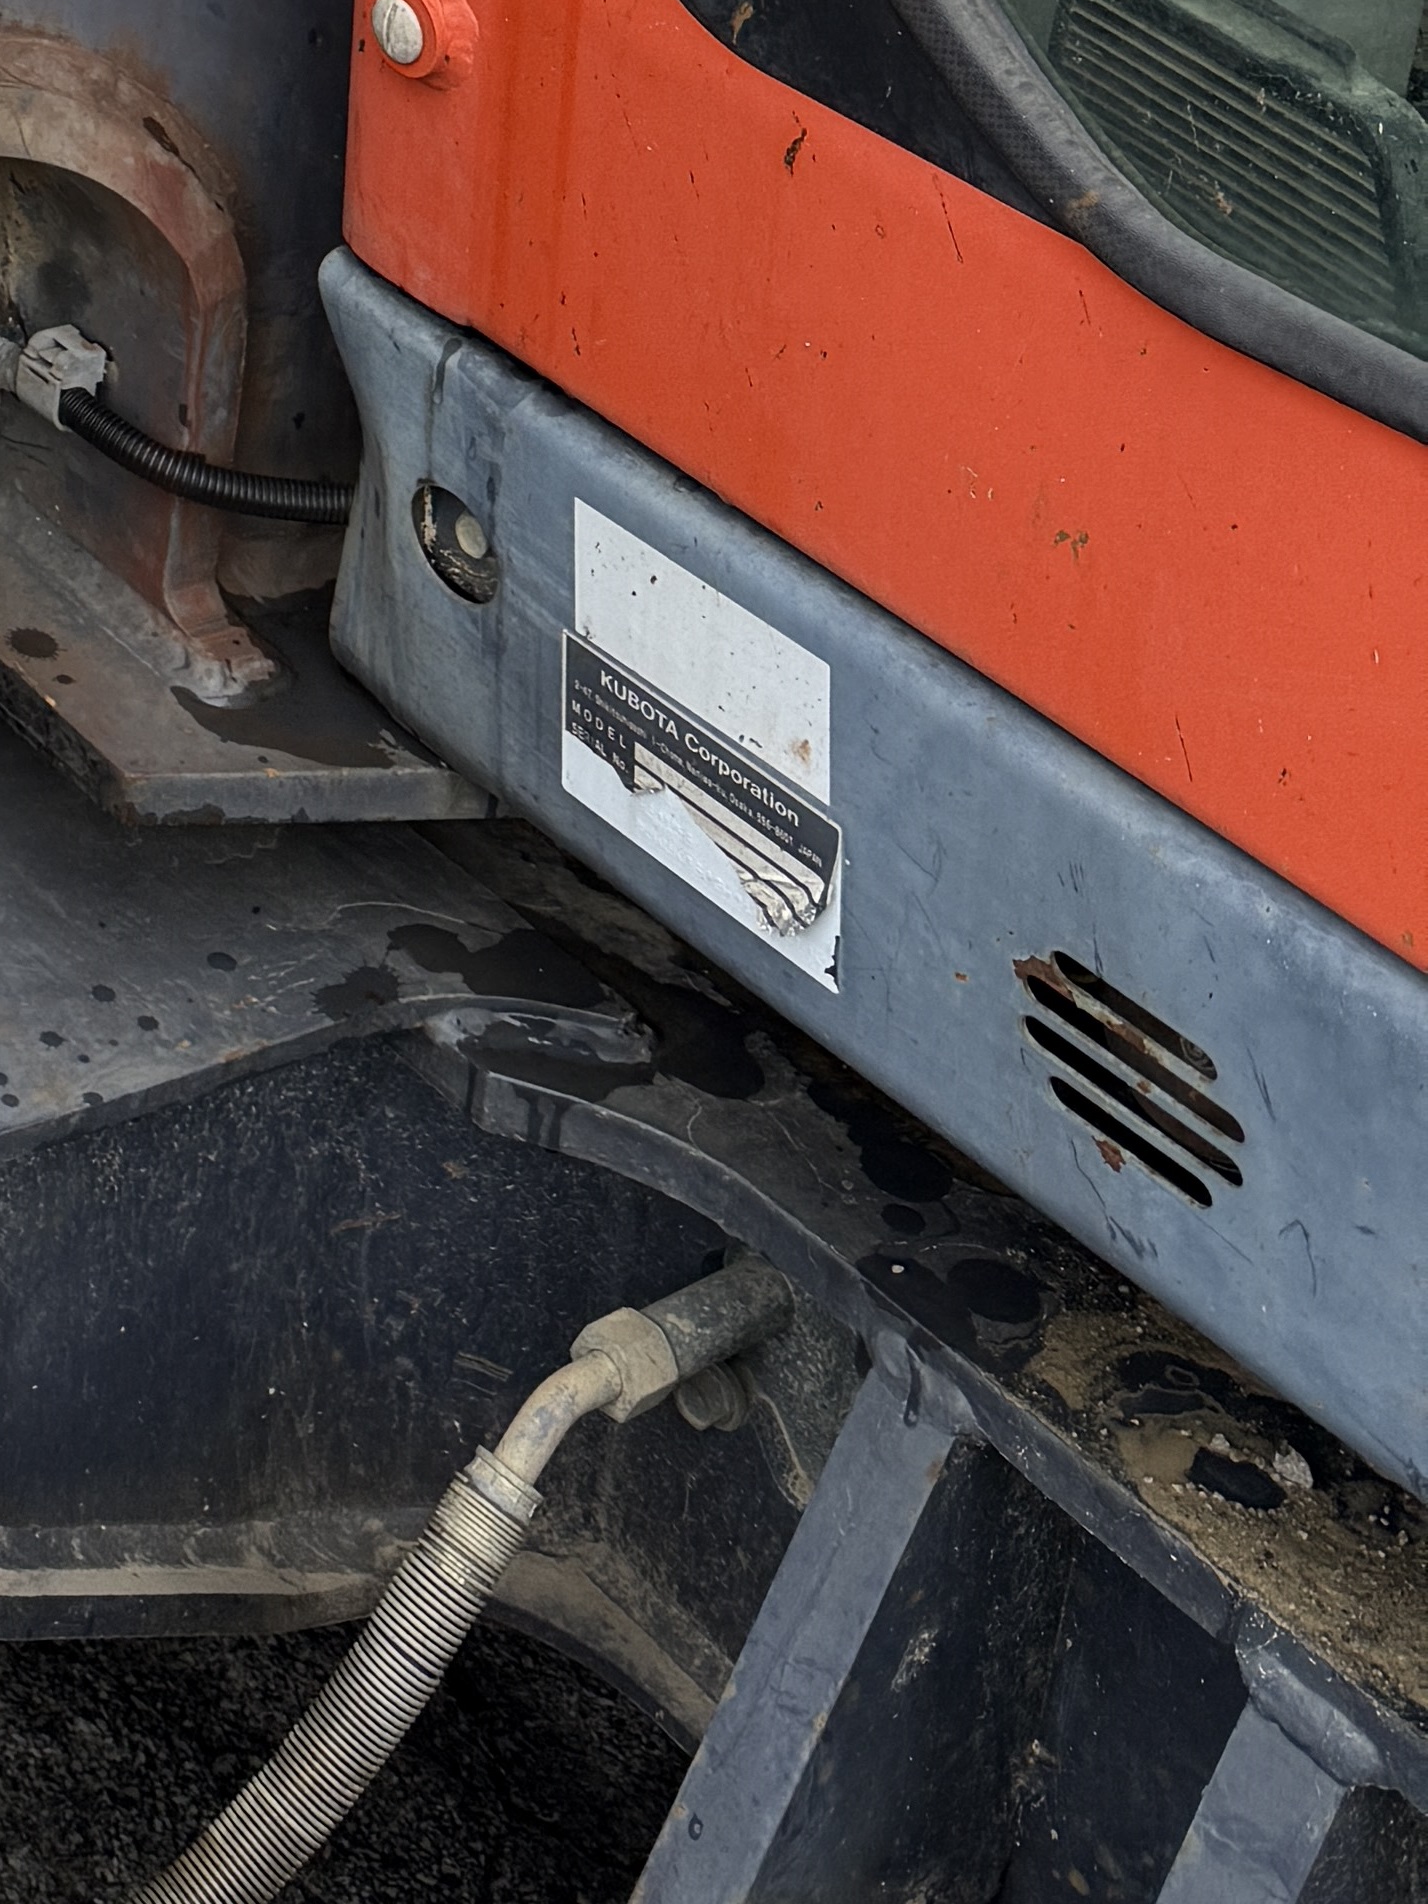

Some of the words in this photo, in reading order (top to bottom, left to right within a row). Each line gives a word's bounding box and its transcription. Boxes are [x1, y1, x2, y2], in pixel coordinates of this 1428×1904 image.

[571, 699, 627, 749] MODEL
[571, 722, 607, 758] SERIAL
[612, 752, 629, 775] No.
[600, 670, 679, 741] KUBOTA
[684, 732, 799, 827] Corporation
